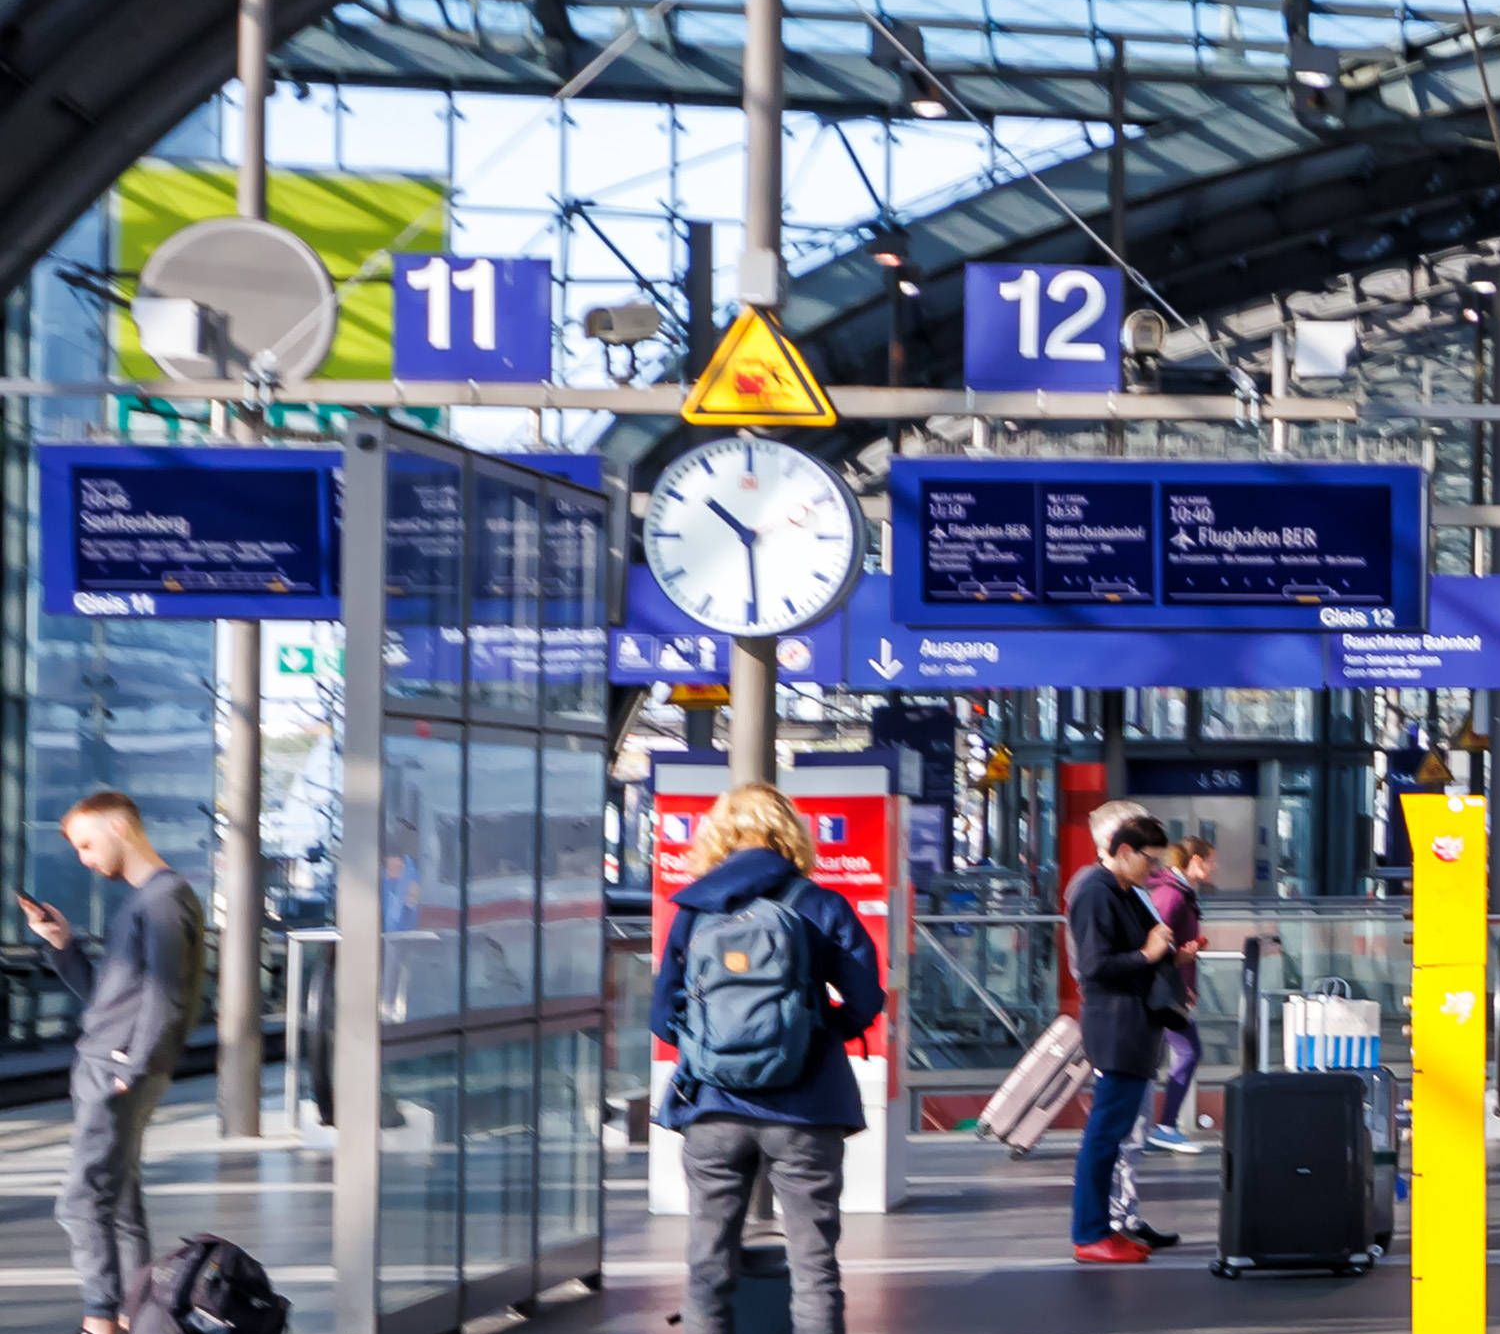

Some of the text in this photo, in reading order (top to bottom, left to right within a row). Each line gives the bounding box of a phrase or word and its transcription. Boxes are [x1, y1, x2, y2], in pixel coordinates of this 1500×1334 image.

[405, 256, 496, 351] 11
[999, 269, 1107, 362] 12
[1198, 525, 1318, 551] Flughafen BER
[73, 592, 156, 615] Gleis 11
[1319, 607, 1396, 628] Gleis 12
[919, 638, 999, 663] Ausgang
[1342, 632, 1482, 652] Rauchfreier Bahnhof
